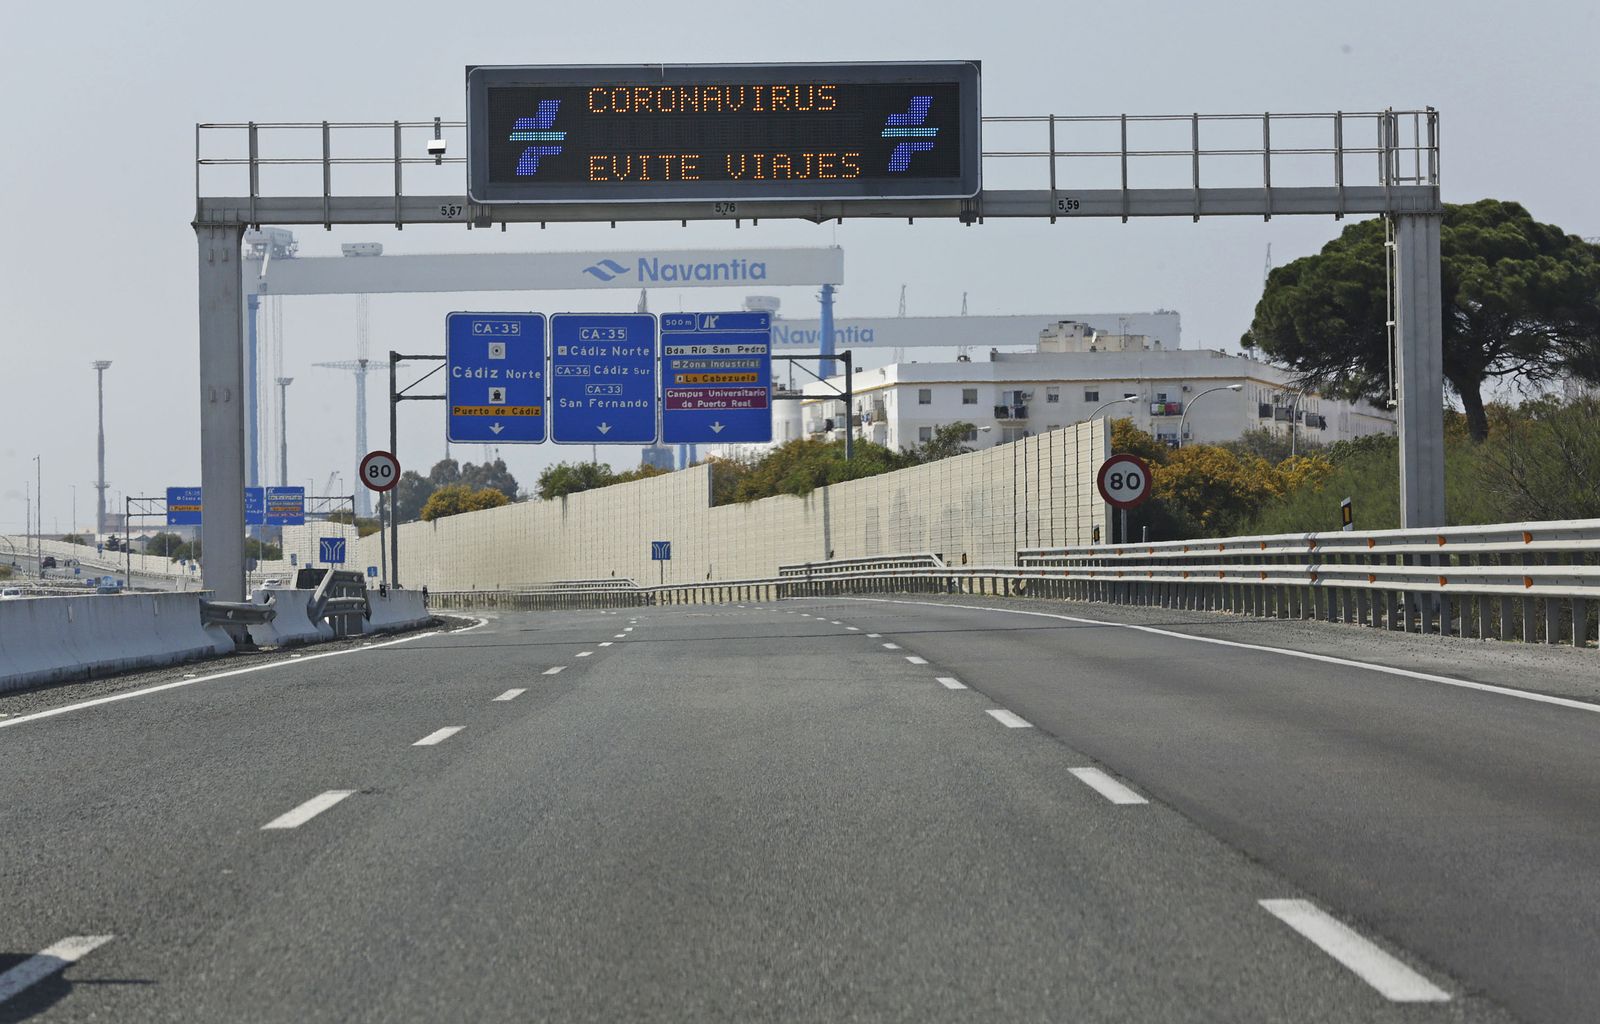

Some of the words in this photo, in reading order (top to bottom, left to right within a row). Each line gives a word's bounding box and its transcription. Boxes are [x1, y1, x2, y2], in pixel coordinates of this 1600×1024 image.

[588, 85, 838, 114] CORONAVIRUS
[589, 153, 700, 182] EVITE
[726, 151, 862, 180] VIAJES
[441, 206, 462, 216] 5,67
[638, 257, 767, 282] Navantia
[474, 324, 518, 333] CA-35
[582, 330, 625, 339] CA-35
[772, 326, 874, 344] Navntia
[571, 346, 606, 356] Cádiz
[612, 346, 650, 356] Norte
[452, 366, 498, 378] Cádiz
[506, 369, 541, 379] Norte
[594, 366, 628, 374] Cádiz
[560, 398, 582, 407] San
[590, 398, 648, 407] Fernando
[454, 407, 489, 415] Puerto
[369, 464, 392, 478] 80
[1110, 472, 1141, 490] 80
